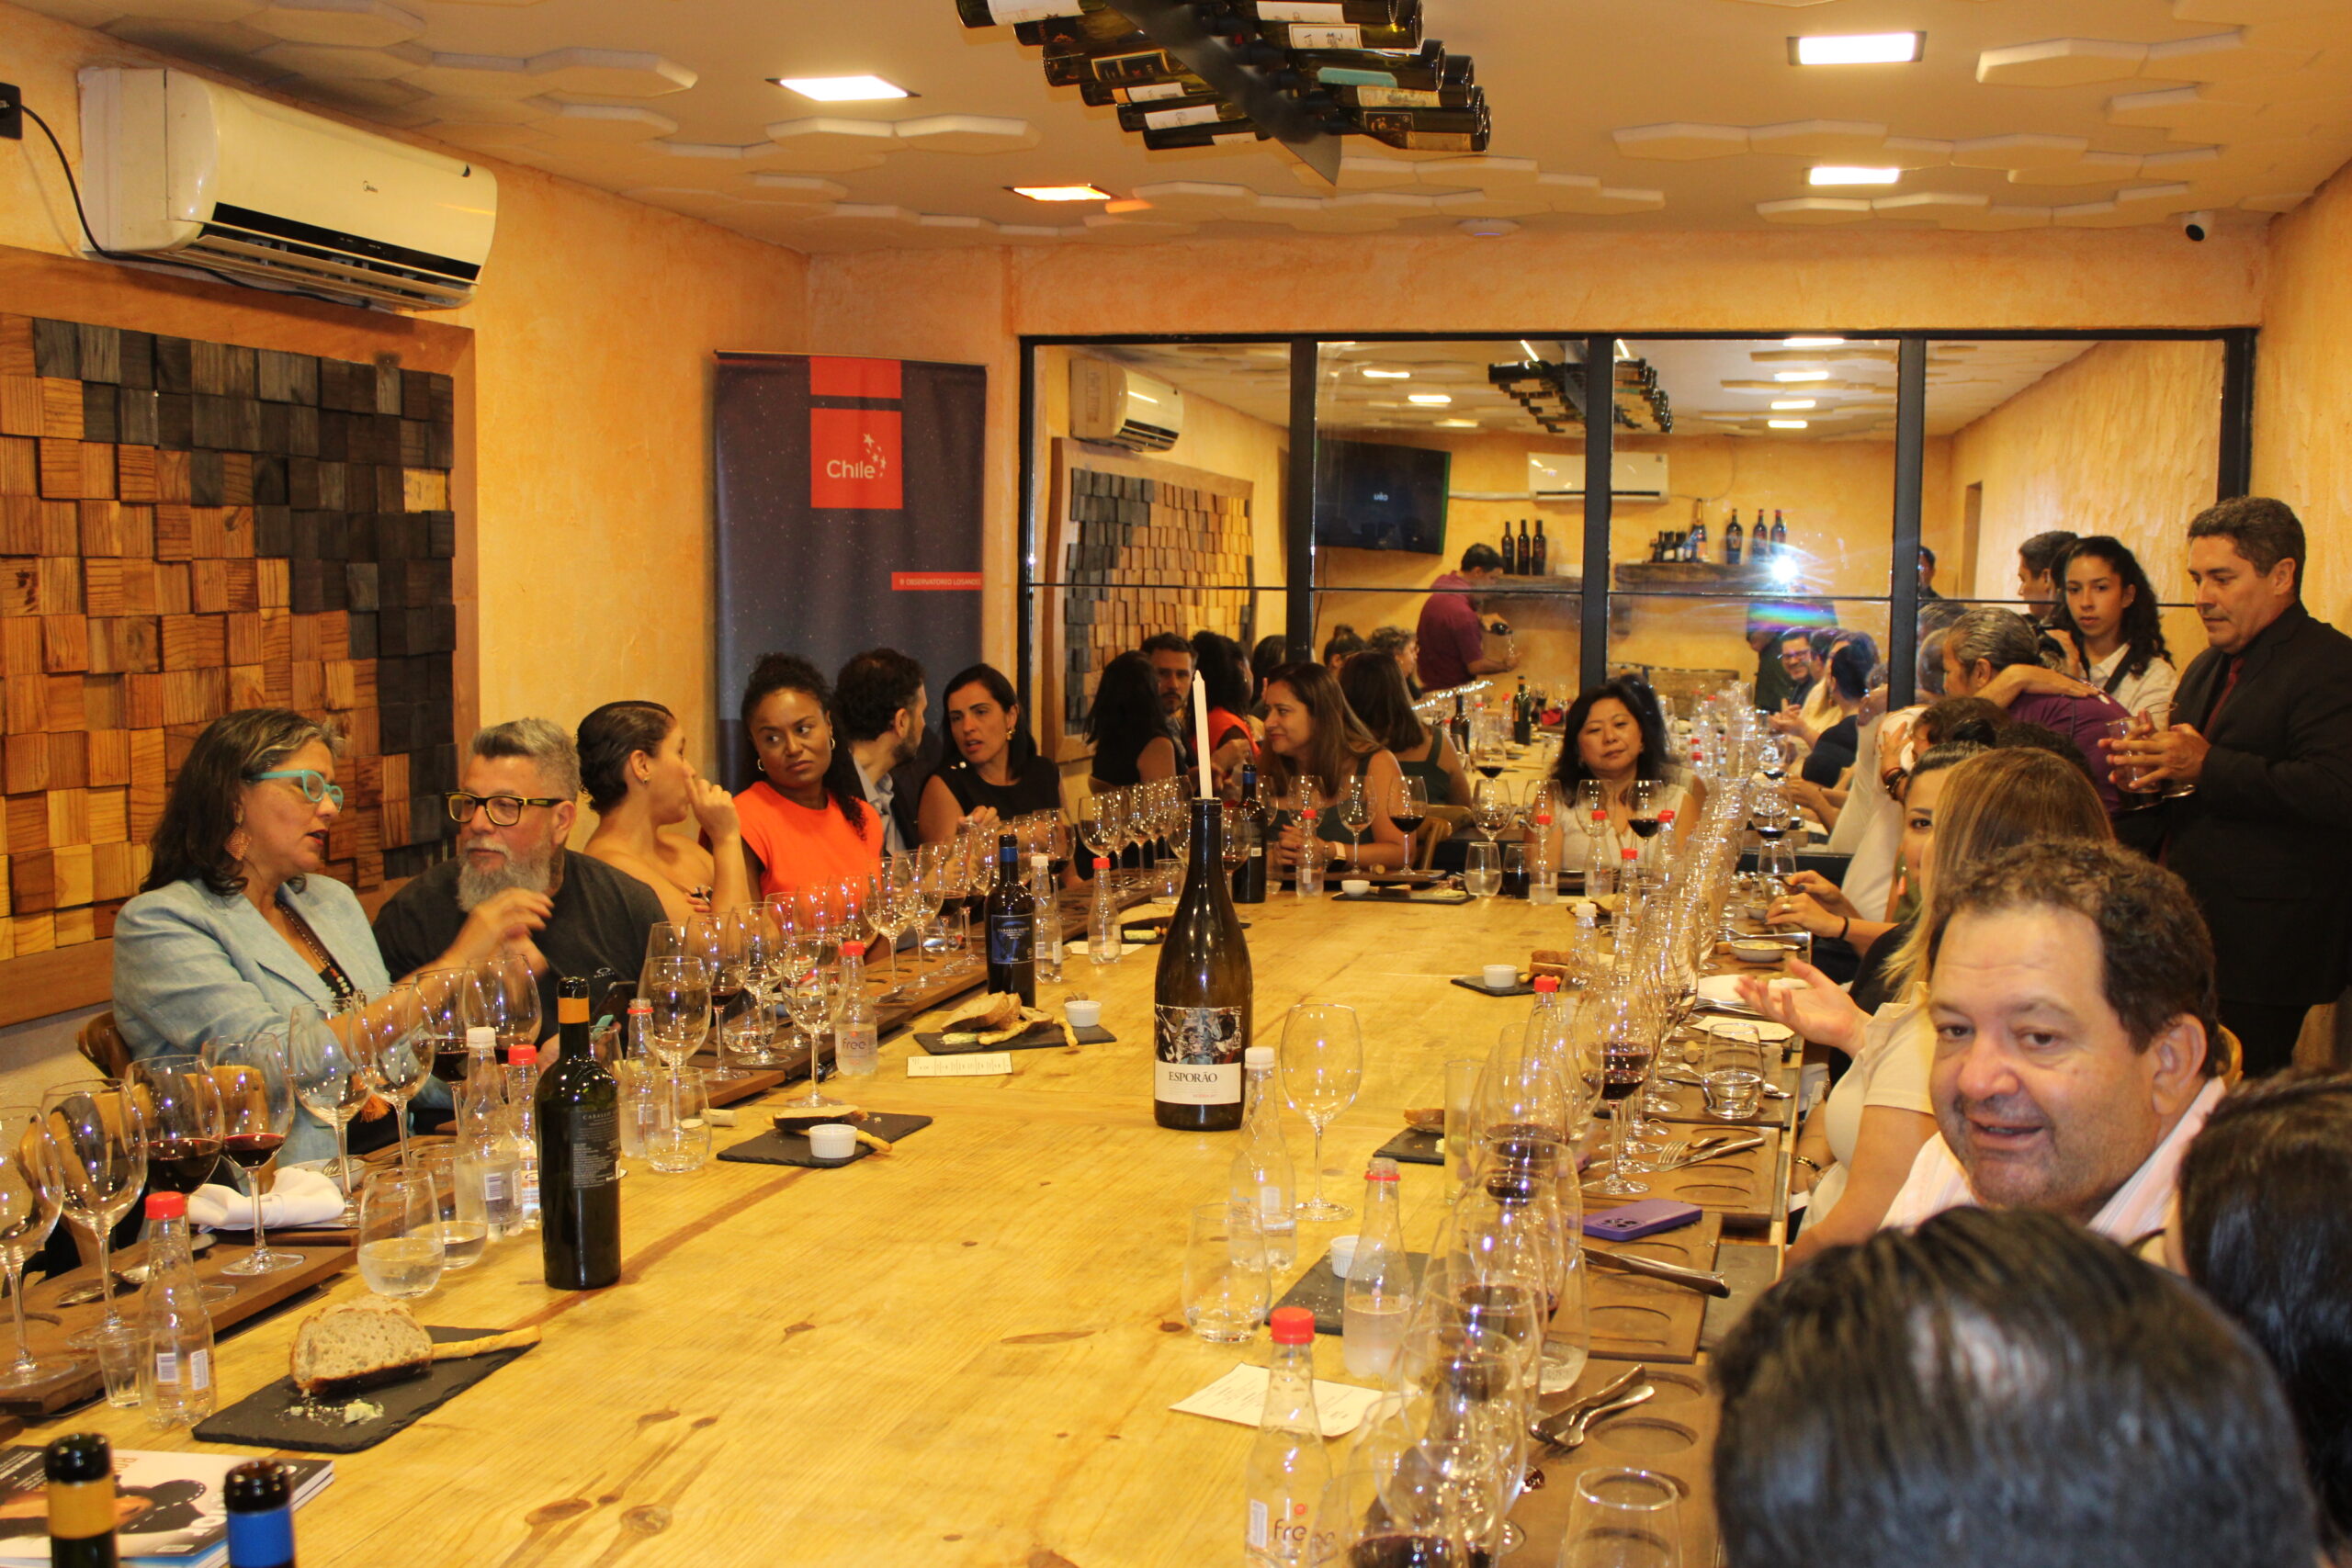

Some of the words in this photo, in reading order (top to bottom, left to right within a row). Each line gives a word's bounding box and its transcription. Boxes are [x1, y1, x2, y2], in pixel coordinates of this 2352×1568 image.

[826, 459, 876, 479] Chile
[906, 578, 953, 586] OBSERVATORIO
[1169, 1071, 1218, 1083] ESPORÃO
